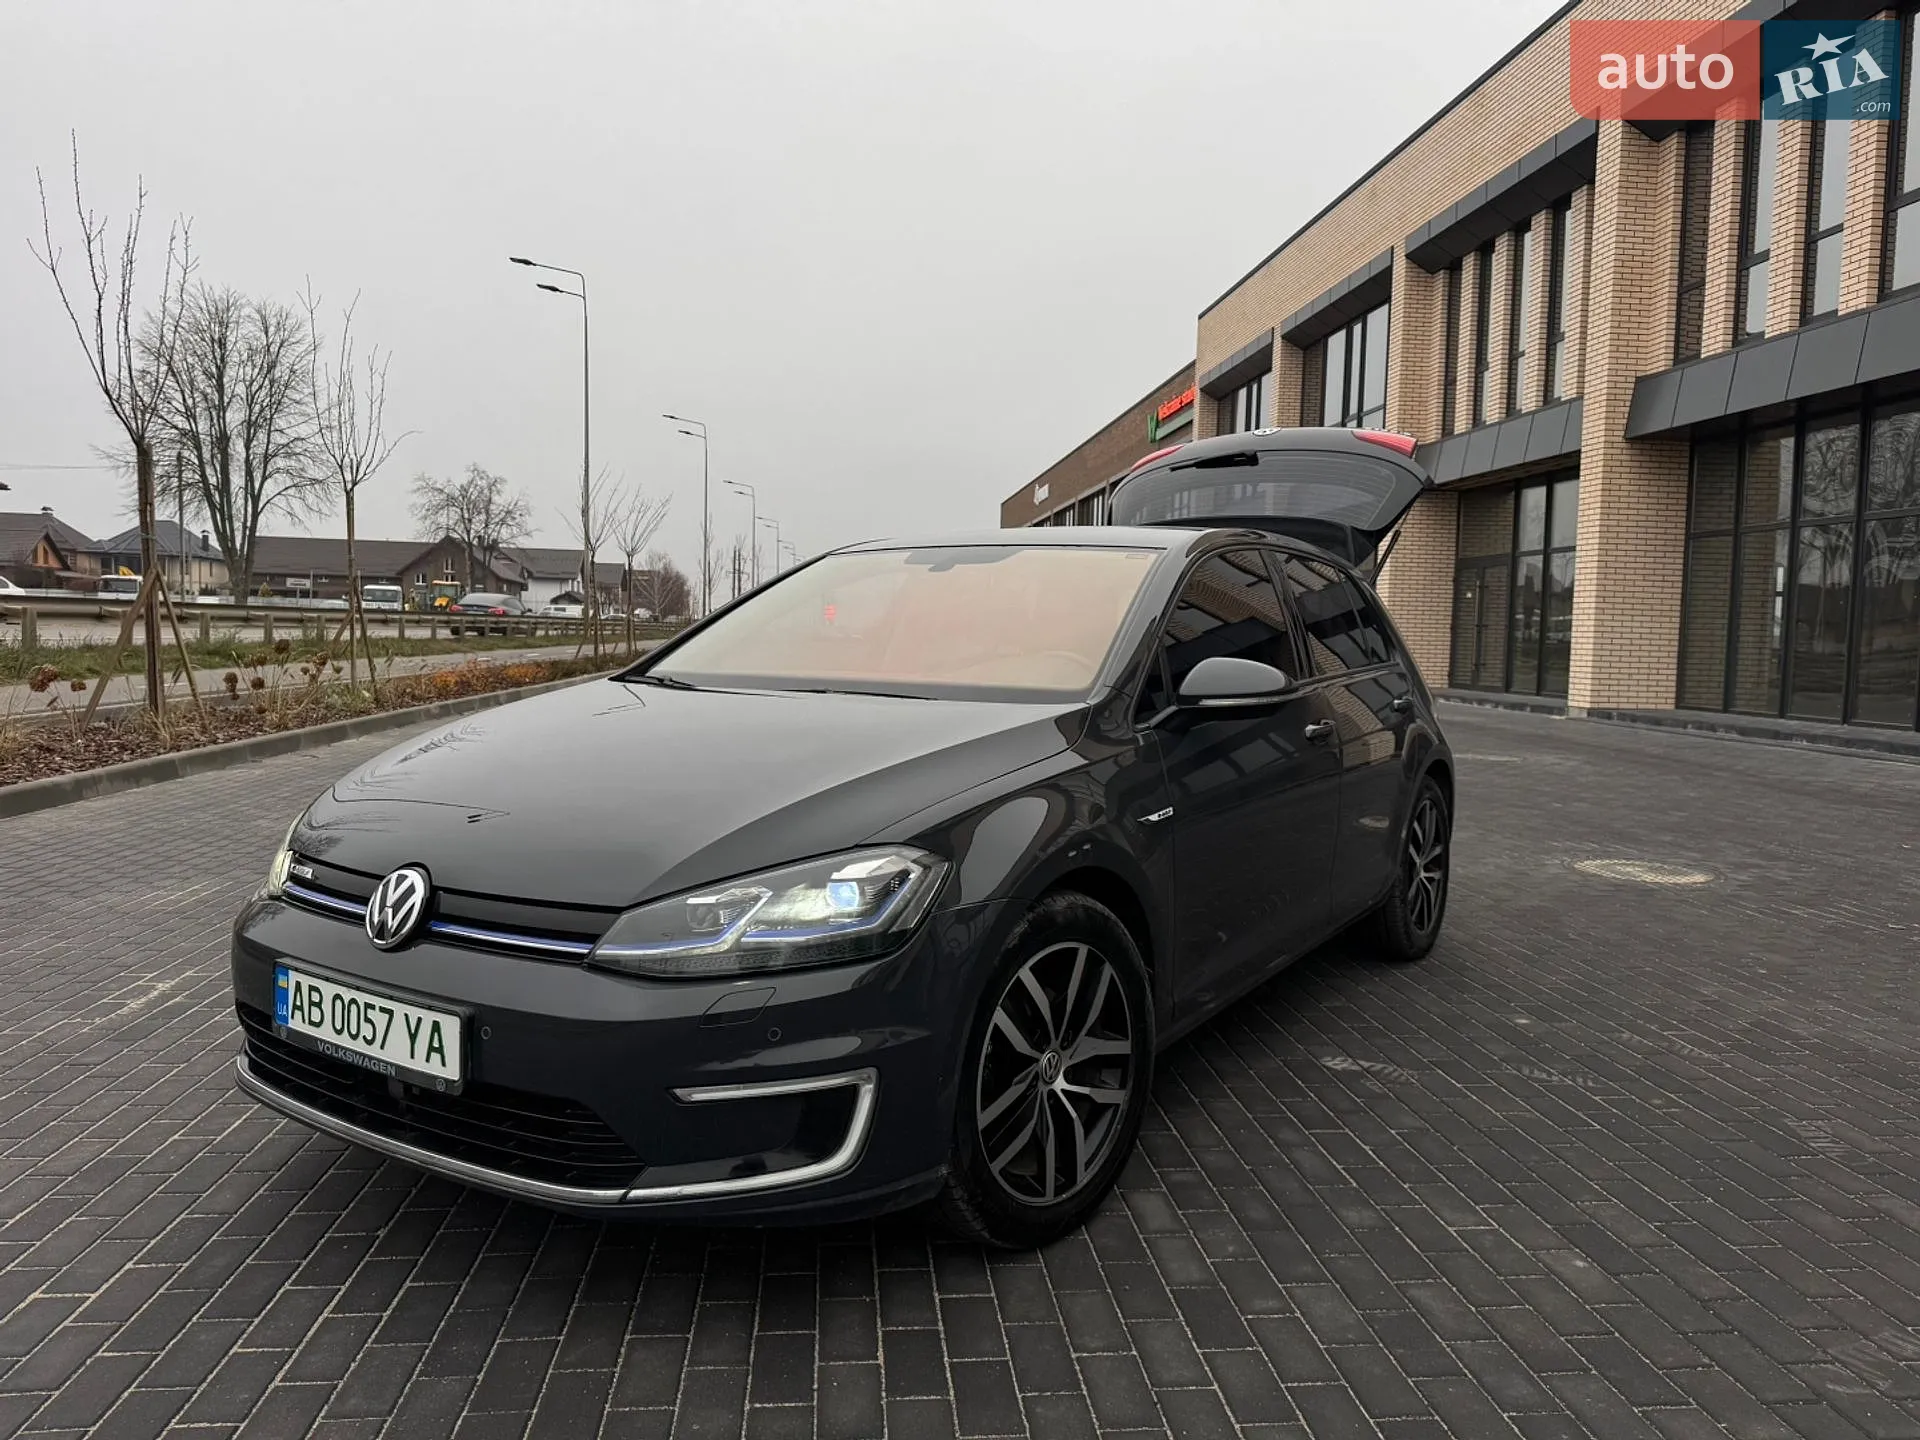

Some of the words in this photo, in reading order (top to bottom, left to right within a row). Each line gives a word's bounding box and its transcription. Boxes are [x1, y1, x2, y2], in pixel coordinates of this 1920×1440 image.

[277, 1002, 288, 1016] UA
[290, 980, 325, 1029] AB
[331, 993, 395, 1051] 0057
[404, 1012, 447, 1068] YA
[317, 1040, 398, 1077] VOLKSWAGEN
